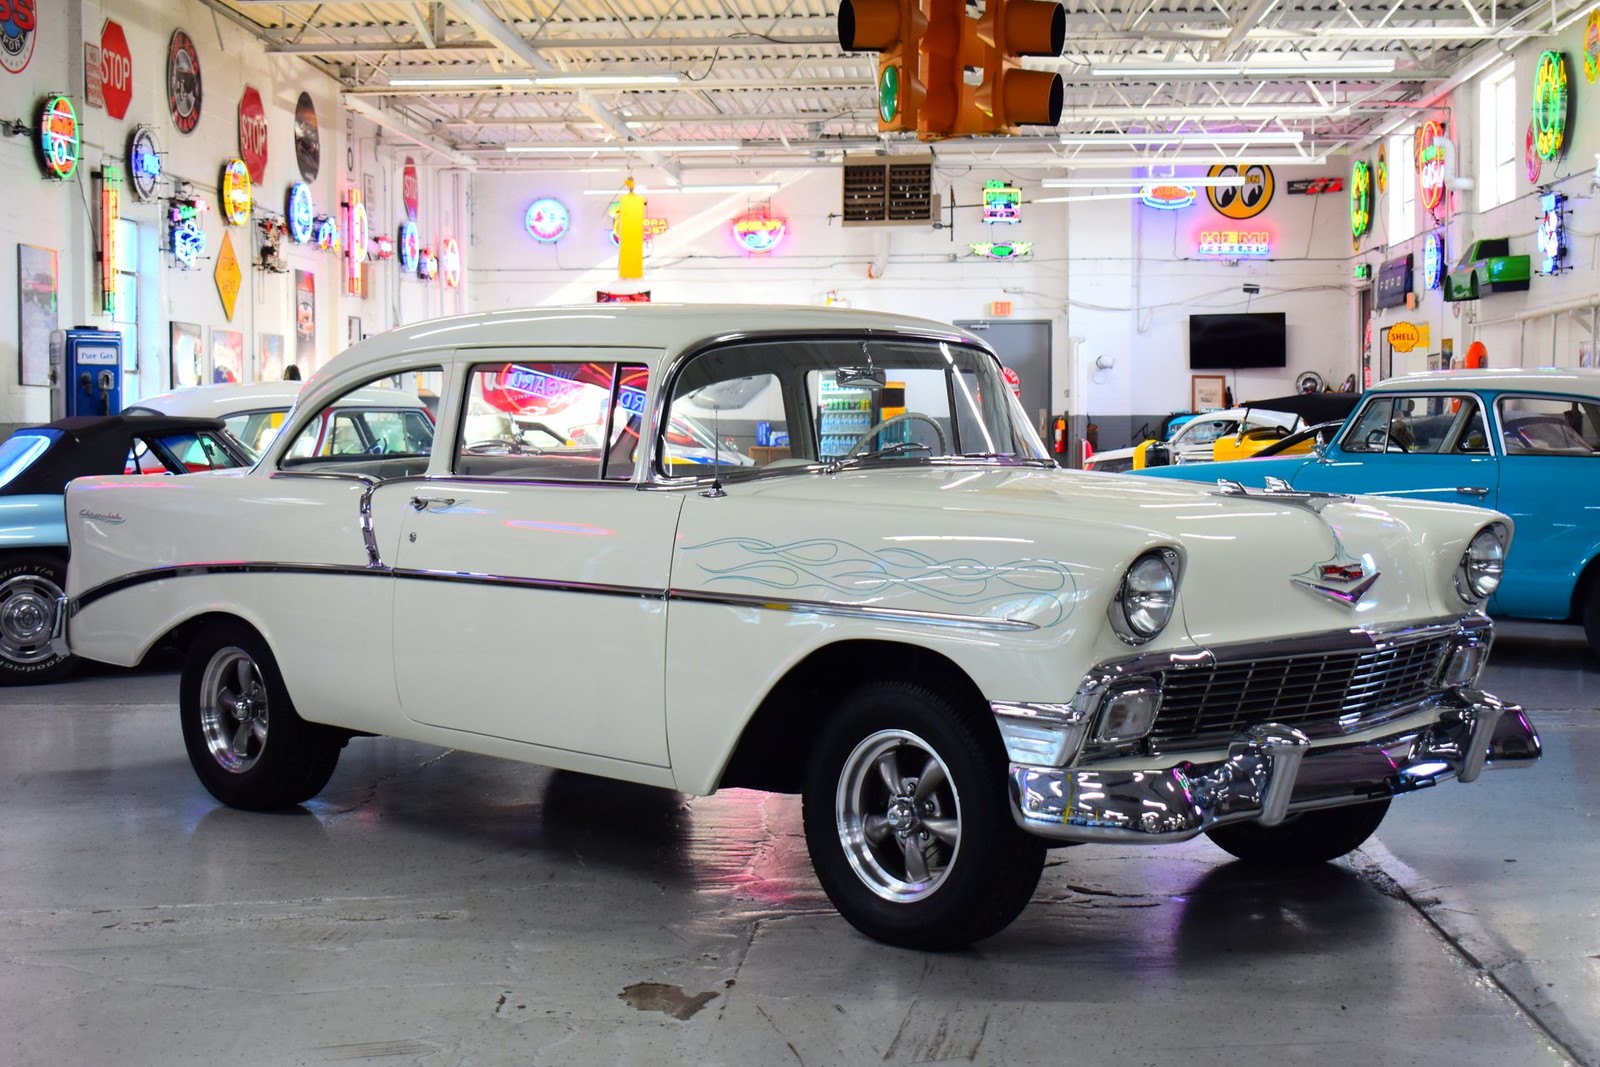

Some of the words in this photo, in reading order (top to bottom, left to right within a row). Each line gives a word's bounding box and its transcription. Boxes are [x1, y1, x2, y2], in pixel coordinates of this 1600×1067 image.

[101, 47, 130, 92] STOP
[240, 113, 268, 157] STOP
[1201, 231, 1269, 244] HEMI
[1380, 275, 1402, 290] FORD
[1391, 333, 1415, 341] SHELL
[81, 352, 97, 360] Pure
[100, 352, 113, 360] Gas
[34, 564, 55, 577] T/A
